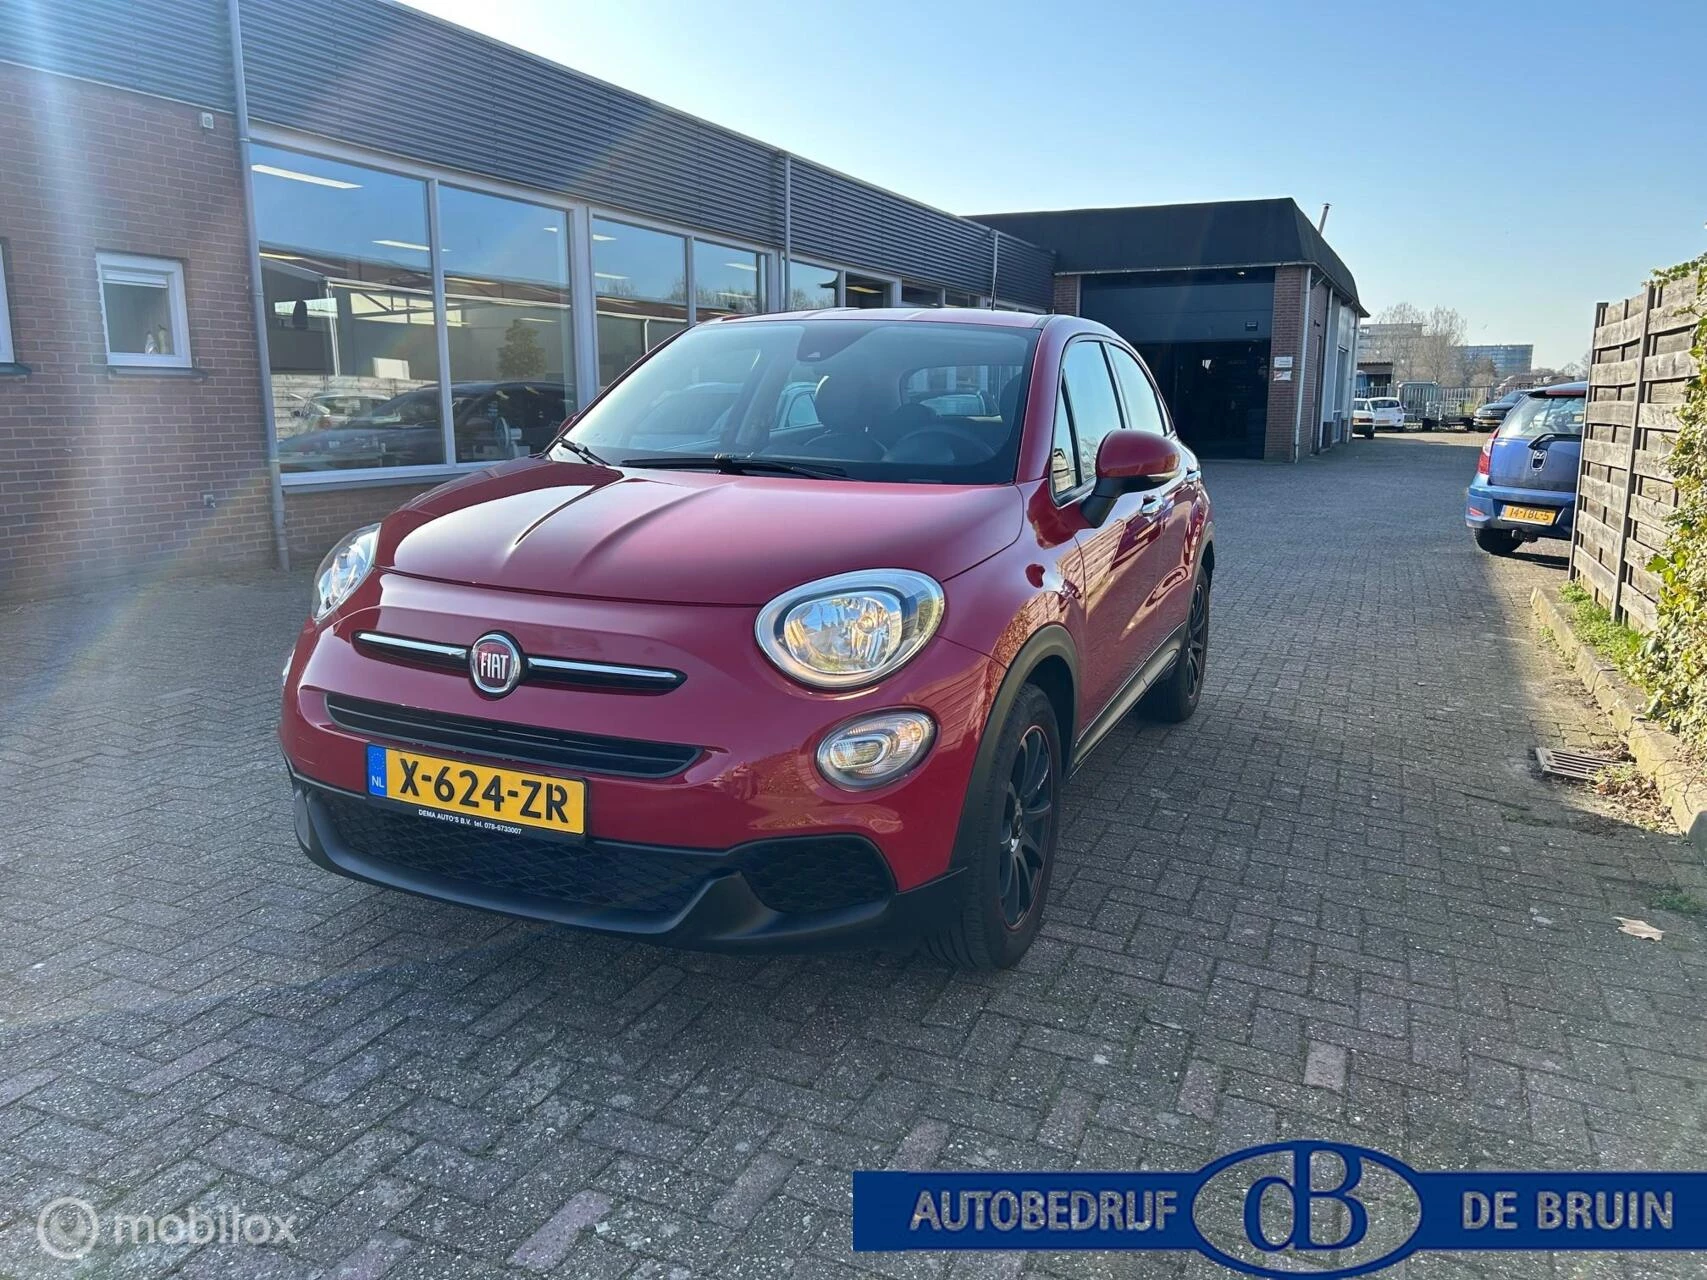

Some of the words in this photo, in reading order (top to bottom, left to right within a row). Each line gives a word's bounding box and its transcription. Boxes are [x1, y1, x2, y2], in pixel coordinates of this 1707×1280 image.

[480, 651, 509, 680] FIAT
[371, 777, 385, 788] NL
[399, 758, 569, 823] X-624-ZR
[418, 809, 436, 819] DEMA
[436, 813, 460, 824] AUTO'S
[460, 817, 472, 826] B.V.
[473, 820, 484, 828] tel.
